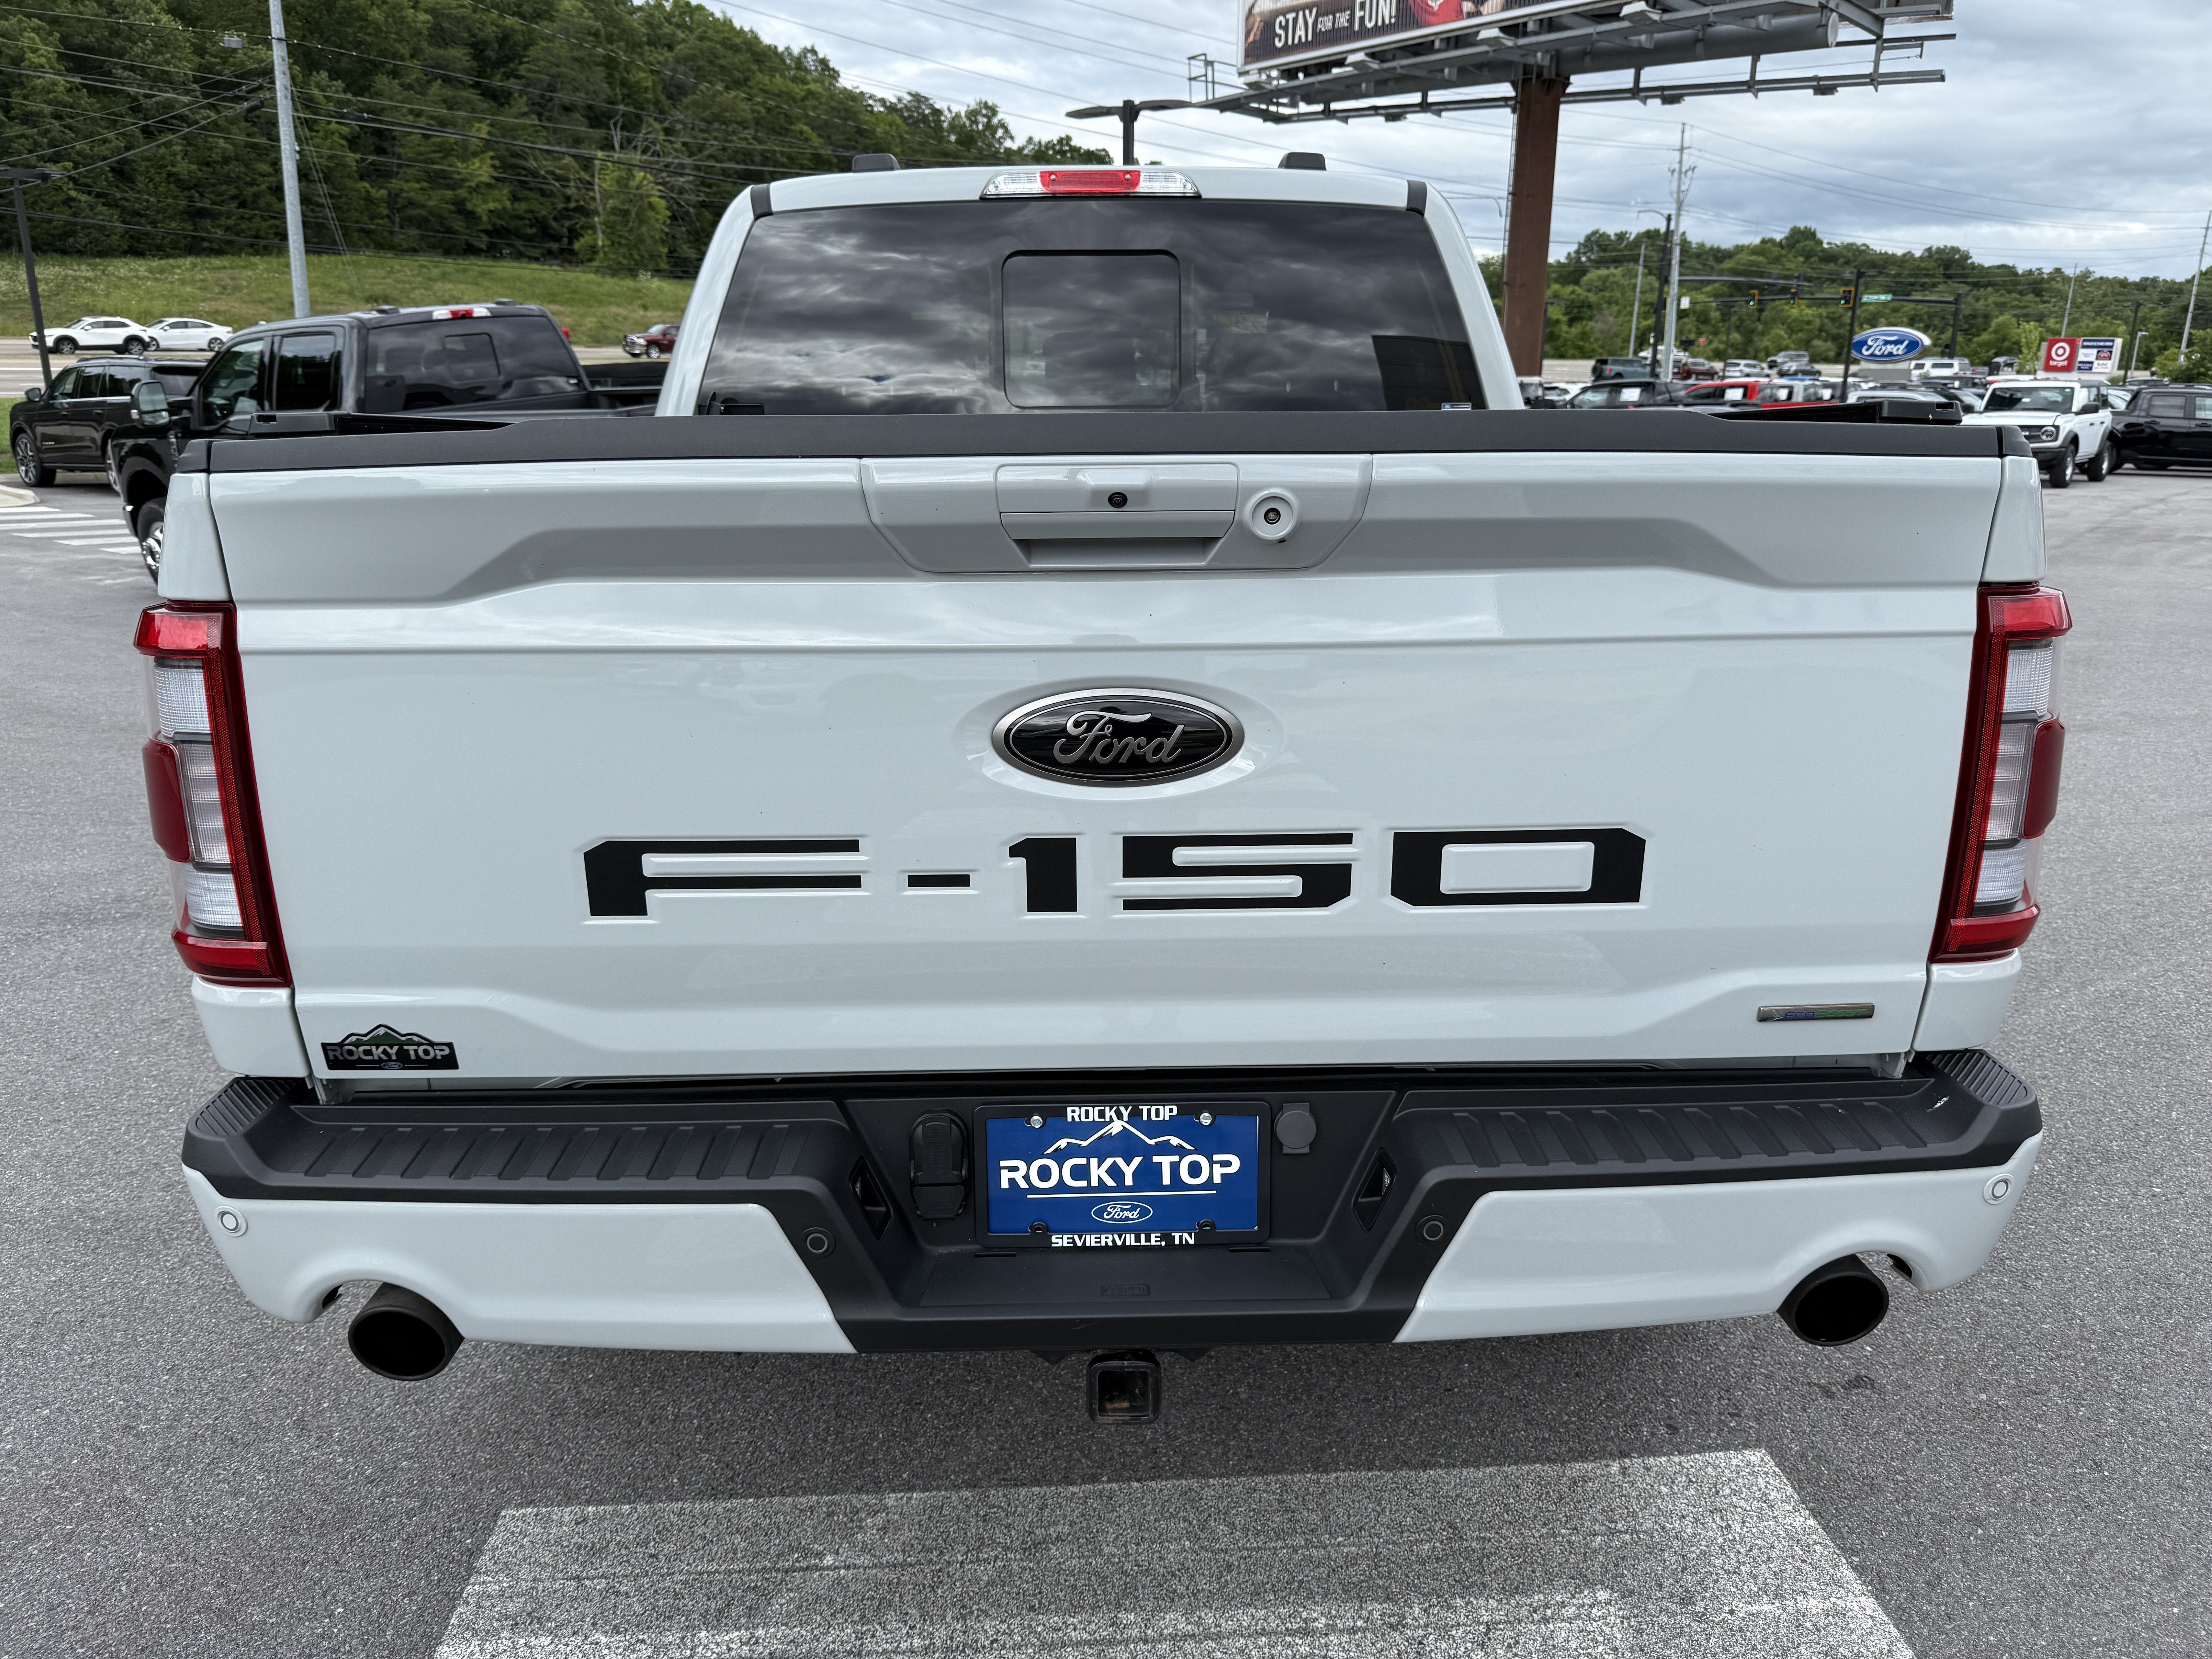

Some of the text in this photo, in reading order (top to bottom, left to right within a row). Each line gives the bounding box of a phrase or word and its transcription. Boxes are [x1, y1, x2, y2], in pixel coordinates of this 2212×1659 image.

[1274, 0, 1396, 48] STAY FOR THE FUN!
[1862, 335, 1909, 356] Ford
[1053, 711, 1185, 764] Ford
[583, 827, 1647, 917] F-150
[326, 1046, 450, 1060] ROCKY TOP
[1066, 1105, 1178, 1122] ROCKY TOP
[1000, 1154, 1241, 1189] ROCKY TOP
[1103, 1205, 1140, 1219] Ford
[1051, 1232, 1195, 1247] SEVIERVILLE, TN
